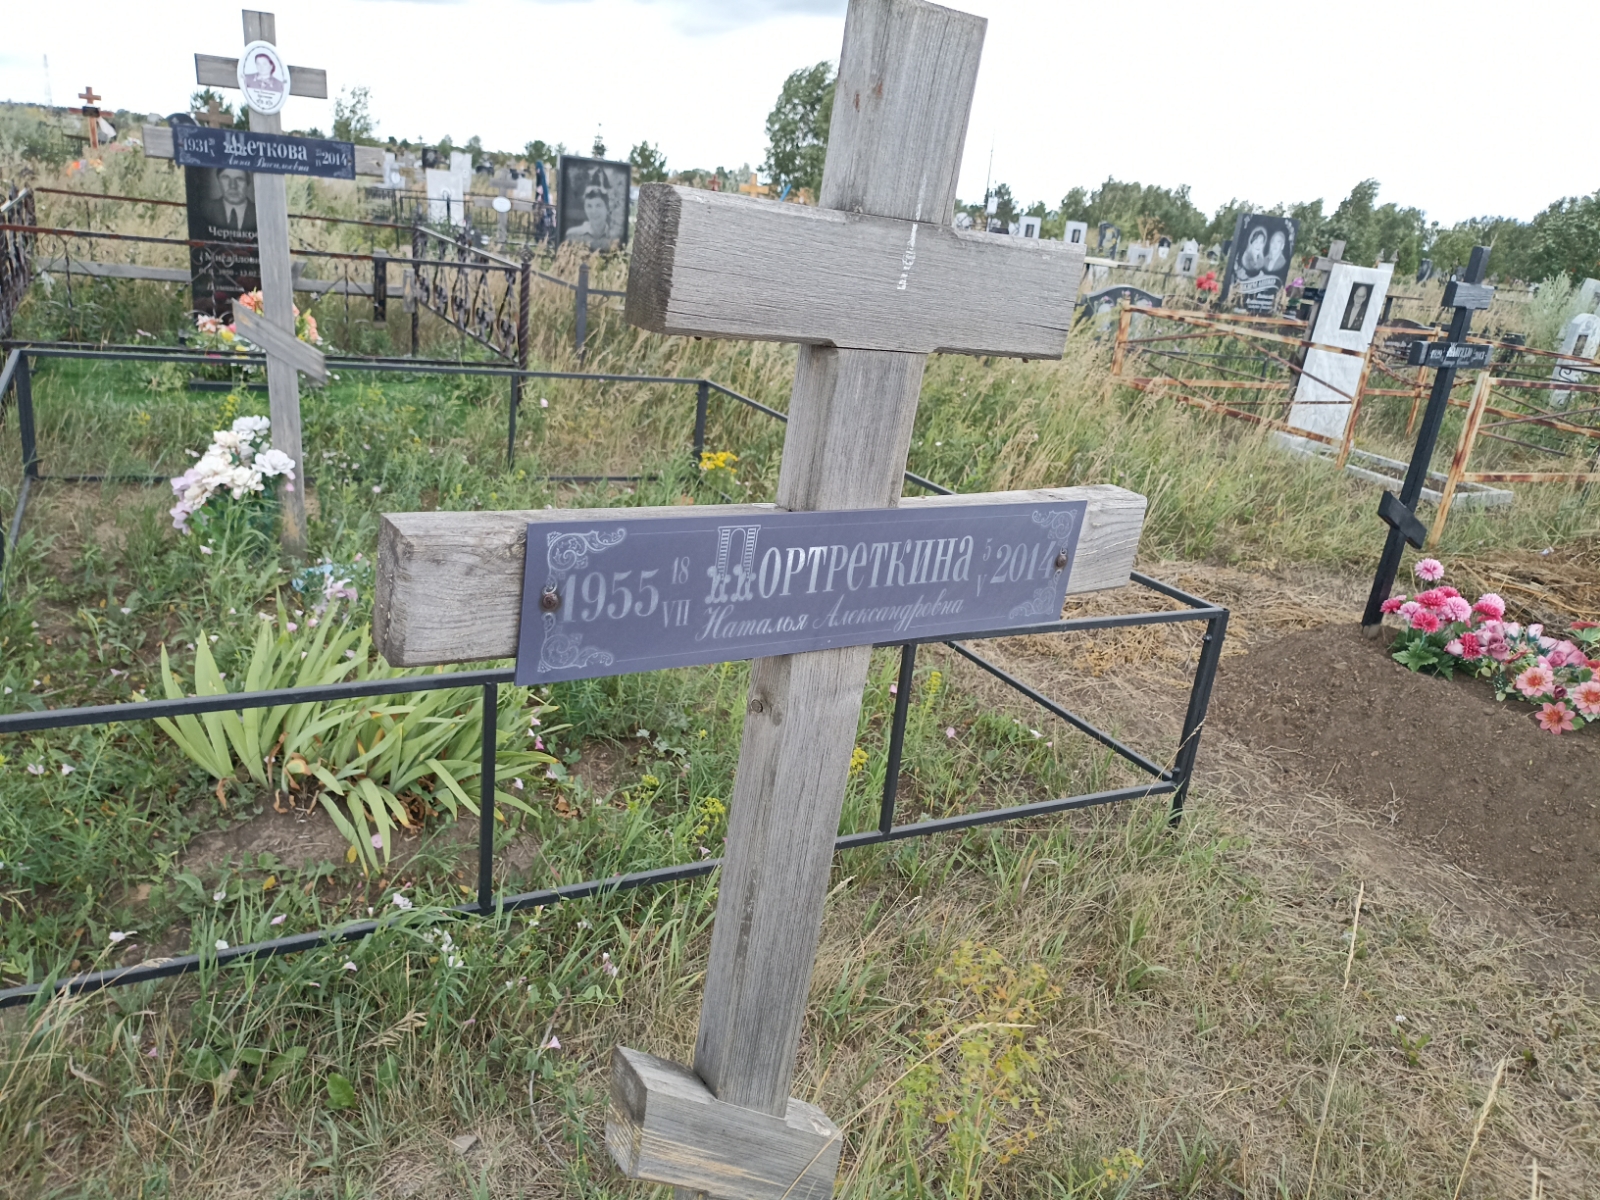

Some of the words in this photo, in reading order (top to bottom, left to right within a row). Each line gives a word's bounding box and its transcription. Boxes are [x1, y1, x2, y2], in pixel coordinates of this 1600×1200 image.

[183, 138, 209, 153] 1931
[223, 131, 308, 161] Щеткова
[321, 152, 348, 167] 2014
[705, 524, 975, 604] Портреткина
[982, 537, 994, 562] 5
[989, 540, 1057, 585] 2014
[670, 556, 690, 585] 18
[975, 573, 988, 597] V
[560, 568, 660, 623] 1955
[662, 599, 692, 628] VII
[694, 604, 808, 641] Наталья
[812, 588, 965, 633] Александровна
